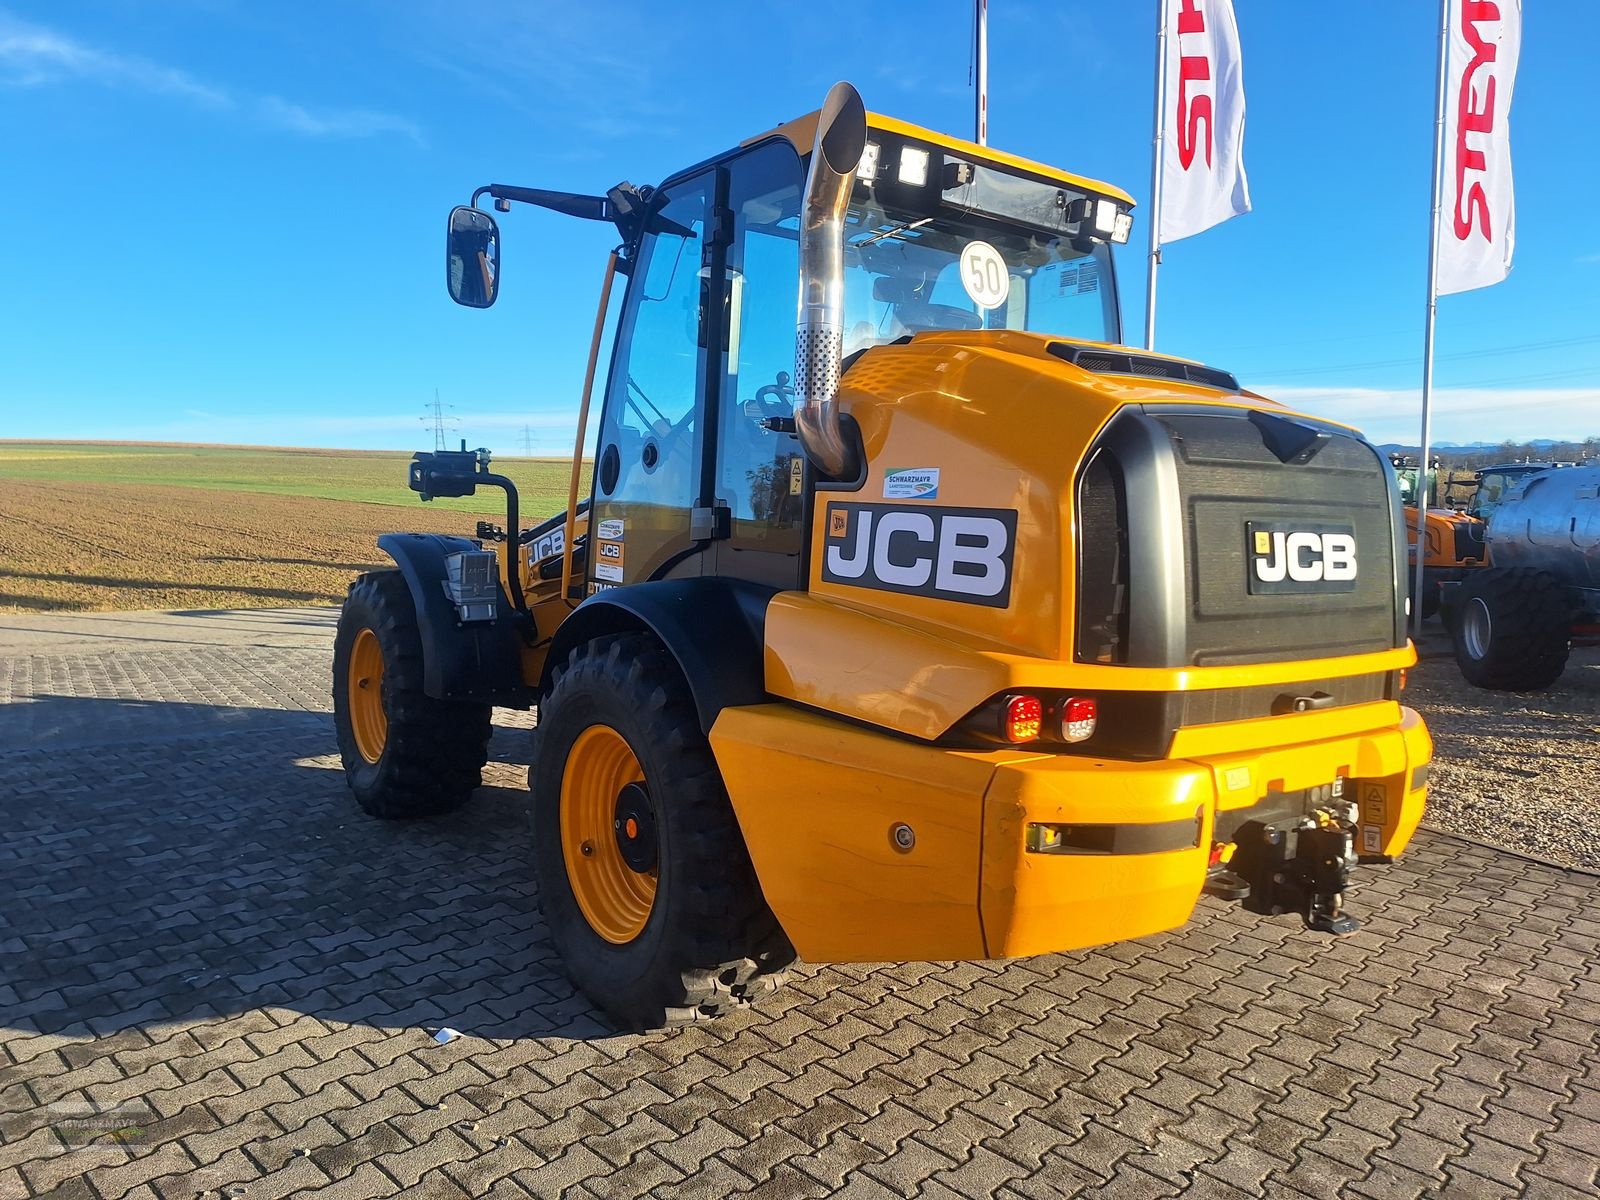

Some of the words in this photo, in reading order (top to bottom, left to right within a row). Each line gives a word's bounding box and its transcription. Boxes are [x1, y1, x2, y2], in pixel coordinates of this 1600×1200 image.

[970, 255, 1000, 296] 50
[888, 475, 931, 483] SCHWARZMAYR
[528, 530, 566, 567] JCB
[600, 543, 620, 558] JCB
[827, 511, 1008, 596] JCB
[1256, 532, 1357, 582] JCB
